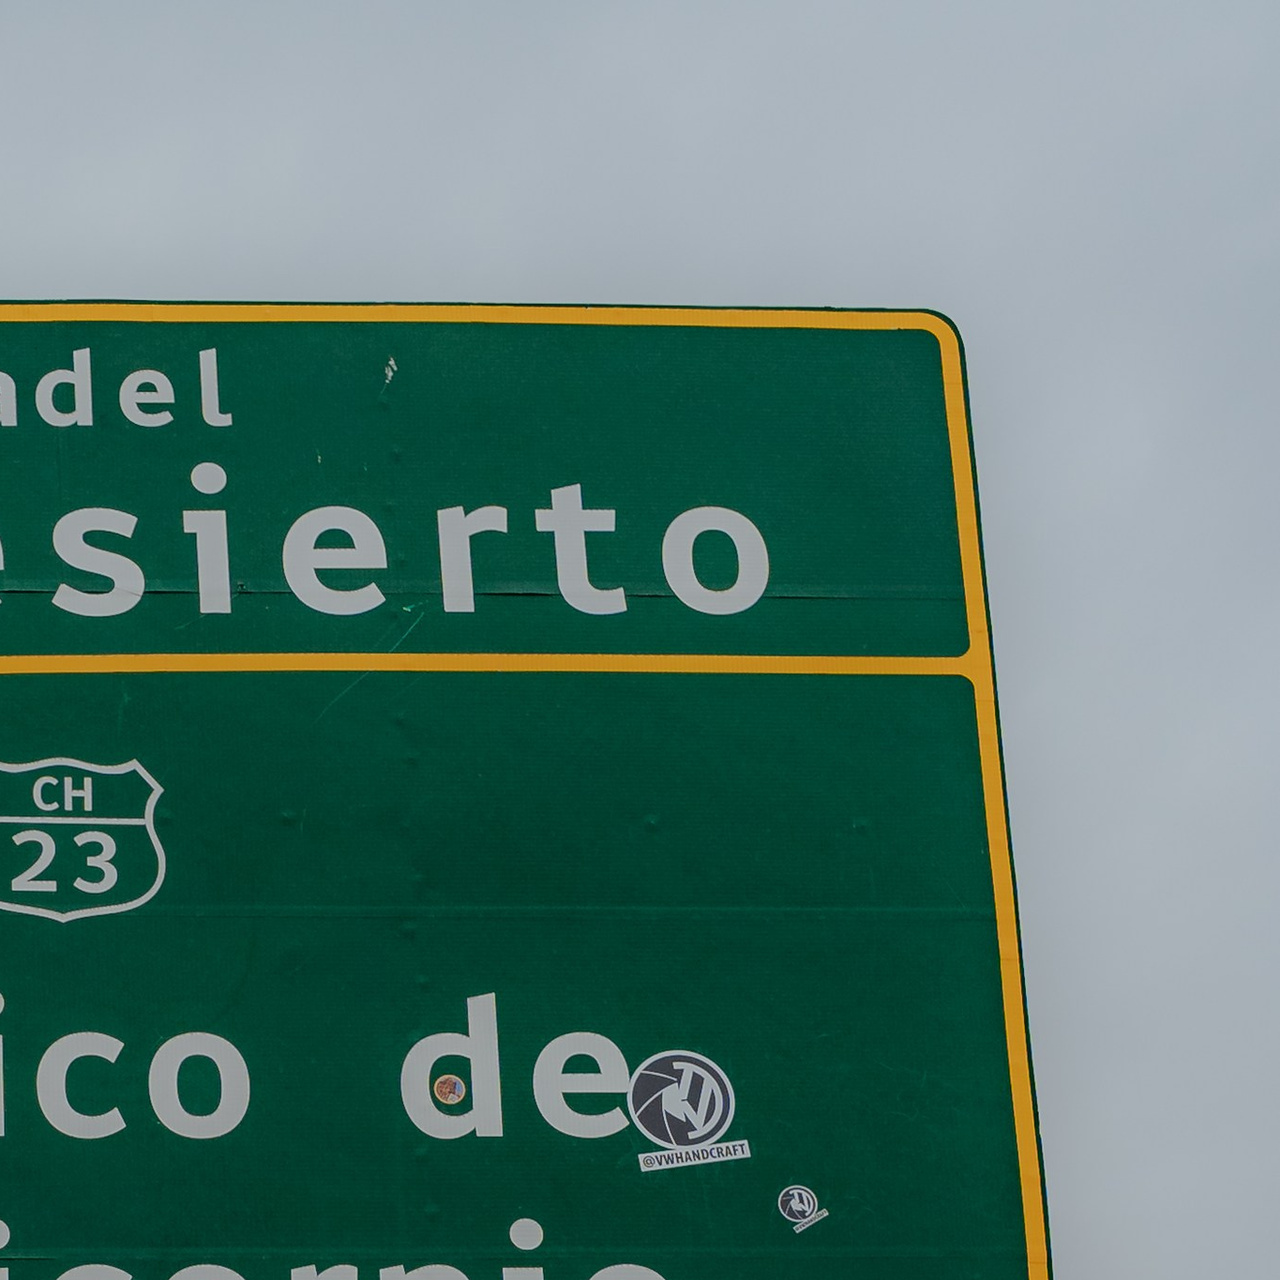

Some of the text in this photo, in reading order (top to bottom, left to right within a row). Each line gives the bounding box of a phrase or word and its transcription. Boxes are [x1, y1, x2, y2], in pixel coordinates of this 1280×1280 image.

[33, 777, 92, 811] CH
[12, 830, 117, 893] 23
[401, 993, 629, 1139] de
[642, 1143, 747, 1168] @VWHANDCRAFT
